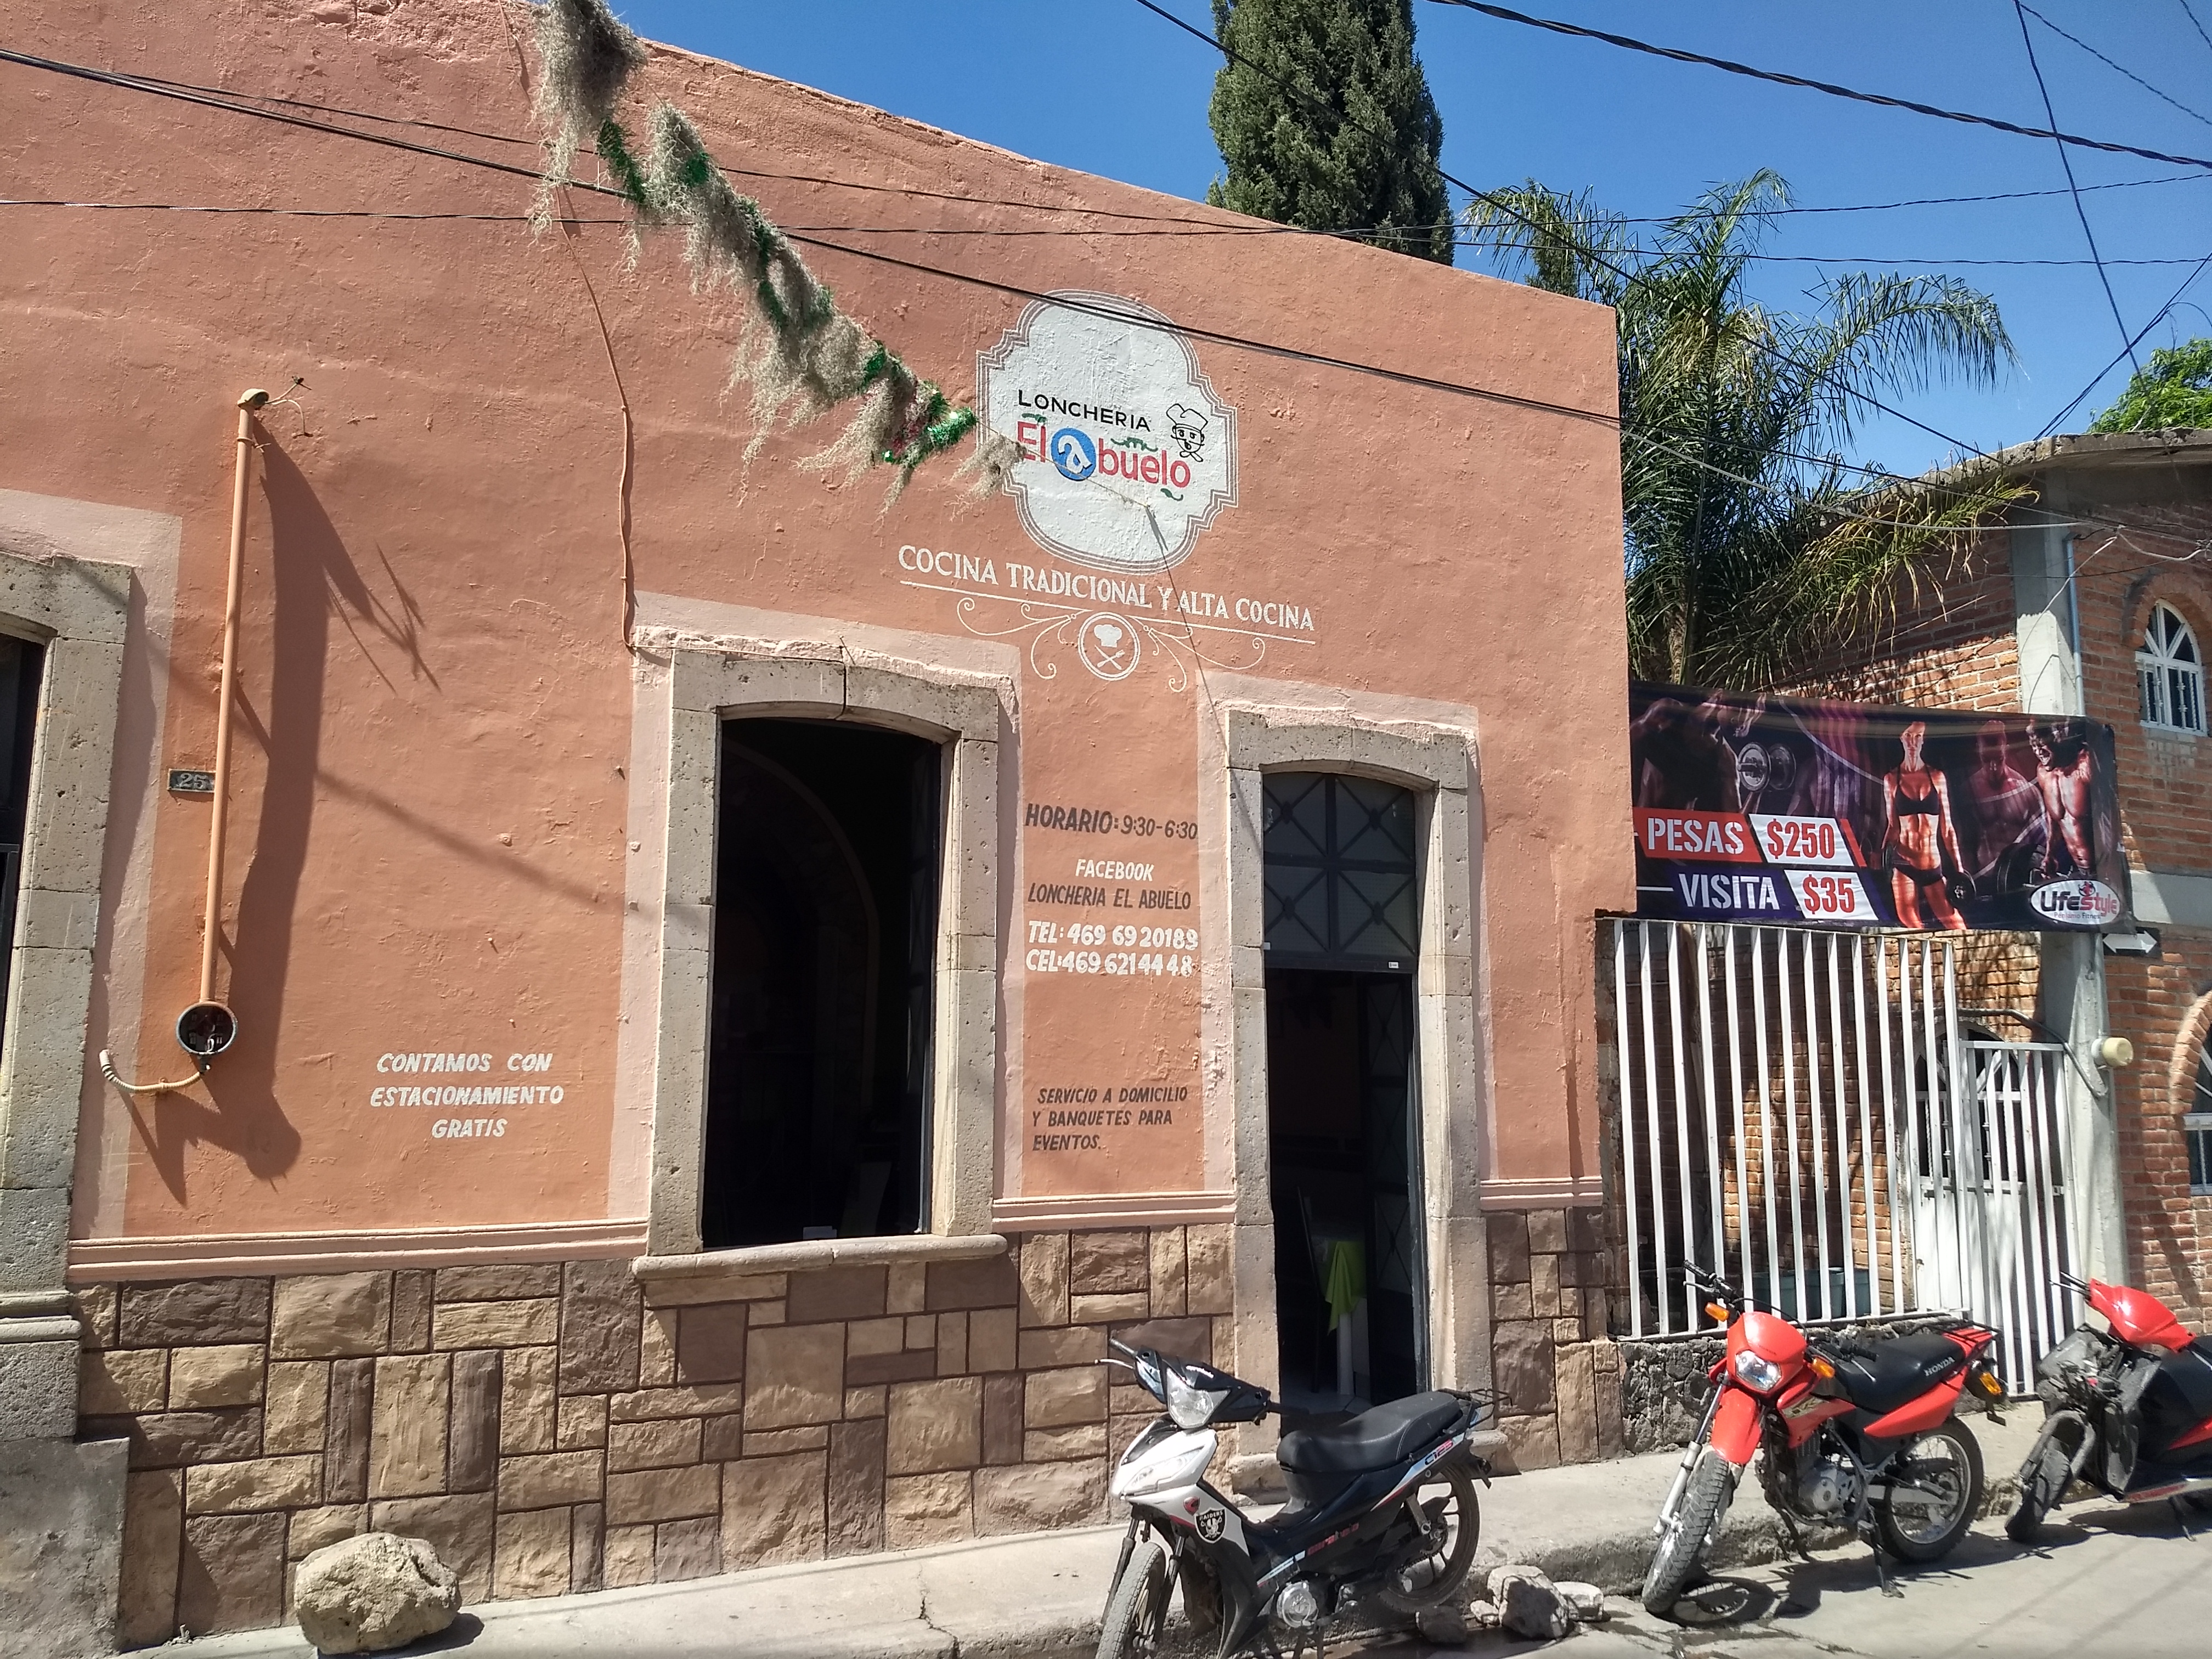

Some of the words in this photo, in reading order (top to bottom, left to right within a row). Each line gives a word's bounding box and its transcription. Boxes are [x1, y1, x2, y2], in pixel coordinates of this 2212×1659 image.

[1018, 390, 1150, 432] LONCHERIA
[898, 545, 998, 585] COCINA
[1006, 562, 1152, 609] TRADICIONAL
[1157, 586, 1173, 612] Y
[1176, 592, 1229, 619] ALTA
[1235, 597, 1315, 632] COCINA
[1025, 803, 1119, 834] HORARIO:
[1647, 817, 1745, 855] PESAS
[1767, 817, 1835, 860] $250
[1075, 858, 1155, 882] FACEBOOK
[1028, 882, 1105, 907] LONCHERIA
[1113, 888, 1133, 909] EL
[1138, 889, 1192, 910] ABUELO
[1678, 872, 1780, 911] VISITA
[1802, 873, 1855, 915] $35
[1028, 920, 1064, 944] TEL:
[1067, 923, 1107, 946] 469
[376, 1052, 493, 1073] CONTAMOS
[506, 1052, 554, 1072] CON
[370, 1085, 565, 1108] ESTACIONAMIENTO
[1037, 1087, 1098, 1104] SERVICIO
[1102, 1087, 1113, 1103] A
[1118, 1086, 1188, 1103] DOMICILIO
[431, 1118, 508, 1139] GRATIS
[1032, 1110, 1041, 1127] Y
[1048, 1109, 1132, 1127] BANQUETES
[1138, 1109, 1173, 1125] PARA
[1032, 1134, 1101, 1151] EVENTOS.
[1923, 1356, 1955, 1376] HONDA
